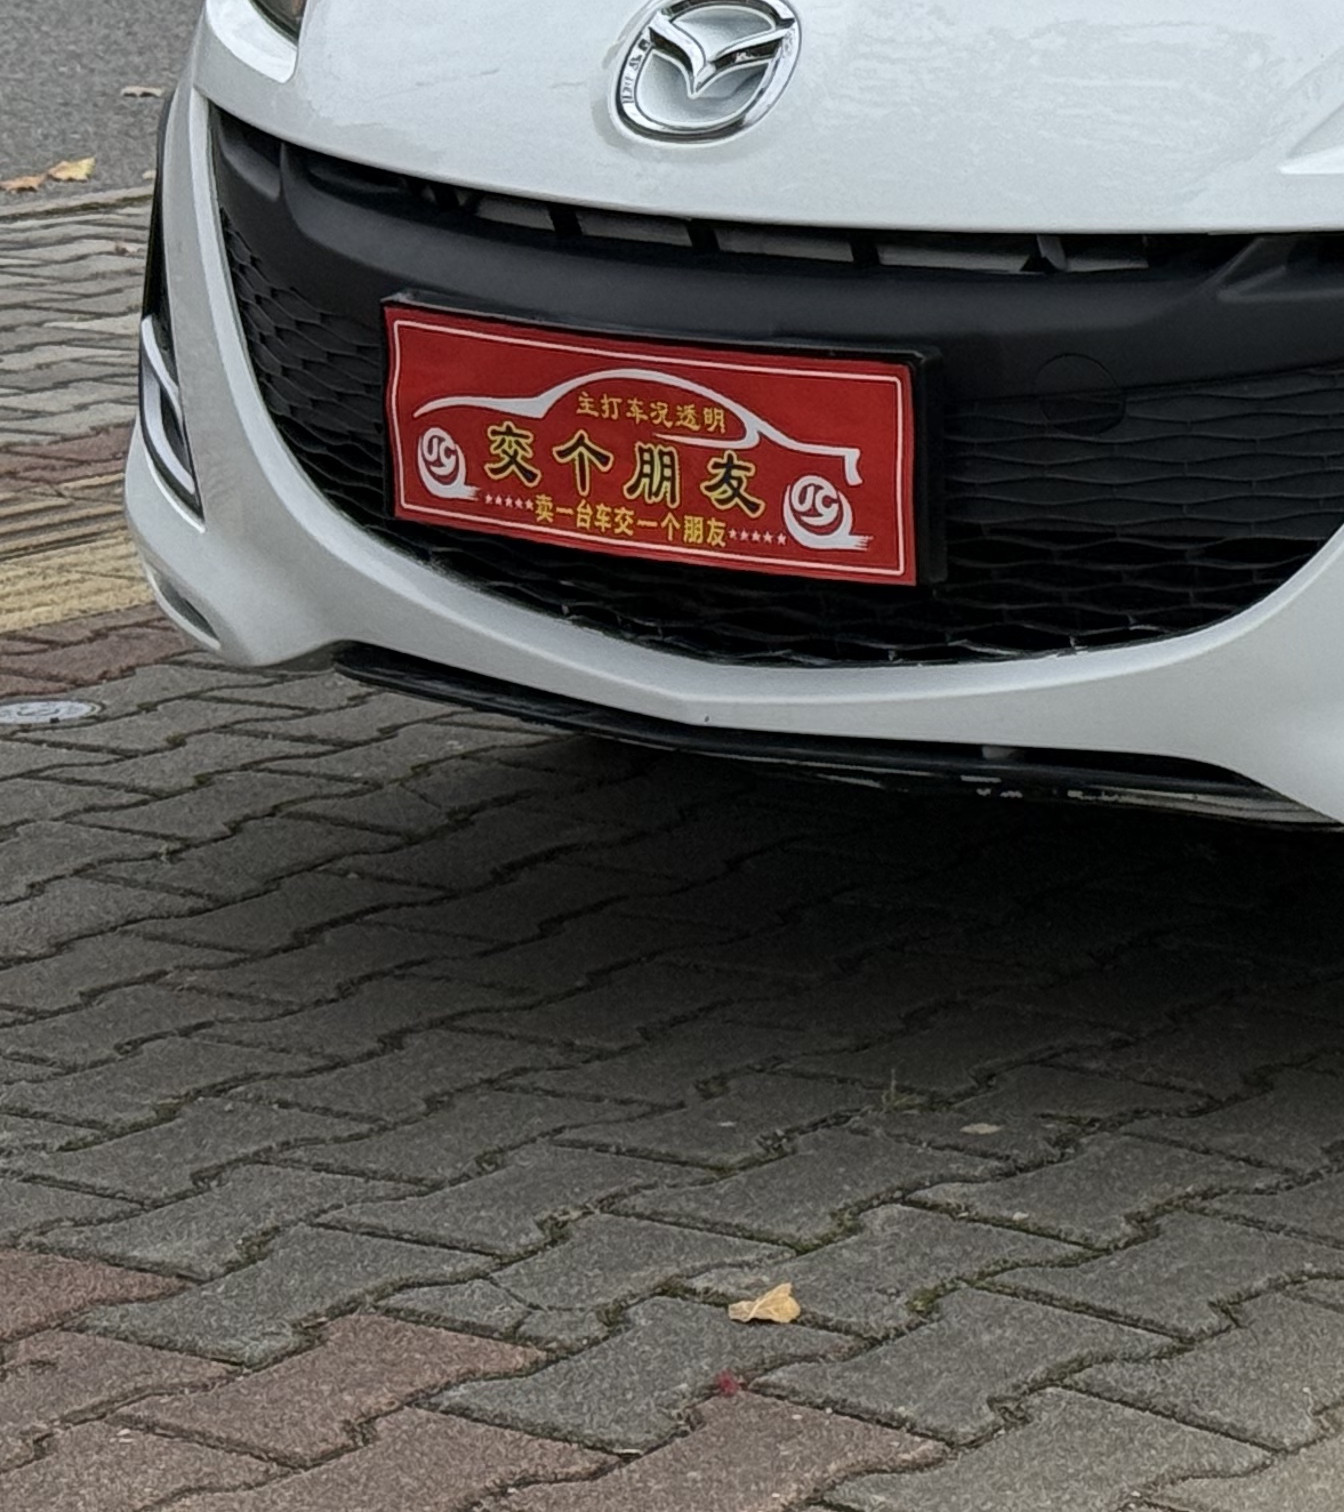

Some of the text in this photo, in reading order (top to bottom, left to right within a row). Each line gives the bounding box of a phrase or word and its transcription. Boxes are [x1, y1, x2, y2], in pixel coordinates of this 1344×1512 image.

[576, 391, 726, 434] 主打车况透明
[484, 420, 766, 517] 交个朋友
[534, 493, 727, 548] 卖一台车交一个朋友
